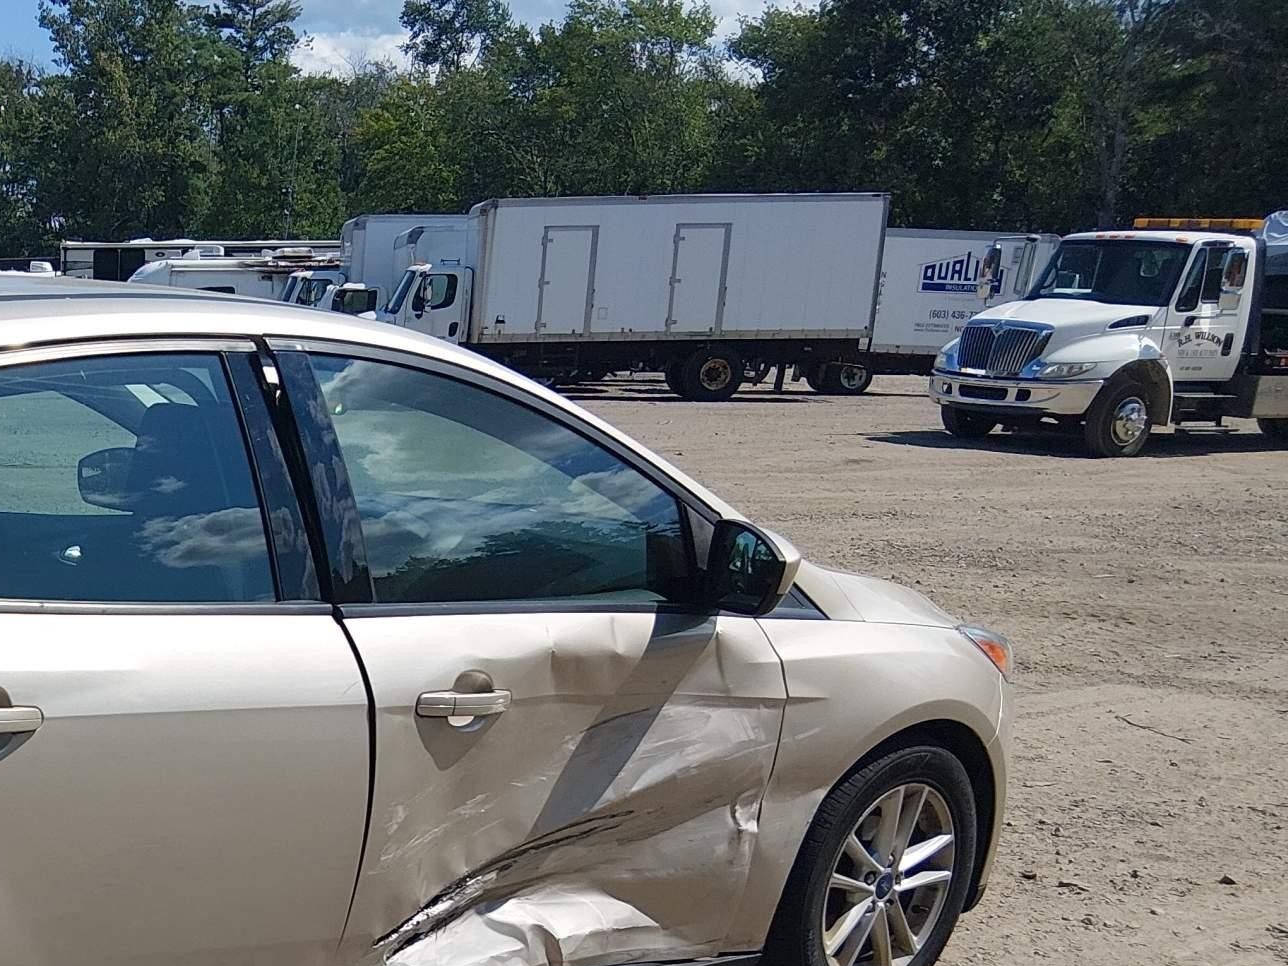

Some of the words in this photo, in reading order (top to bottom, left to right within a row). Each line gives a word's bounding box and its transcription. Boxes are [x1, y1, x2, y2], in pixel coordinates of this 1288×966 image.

[923, 251, 1004, 283] QUALI
[944, 284, 978, 293] INSULATI
[929, 310, 949, 320] (603)
